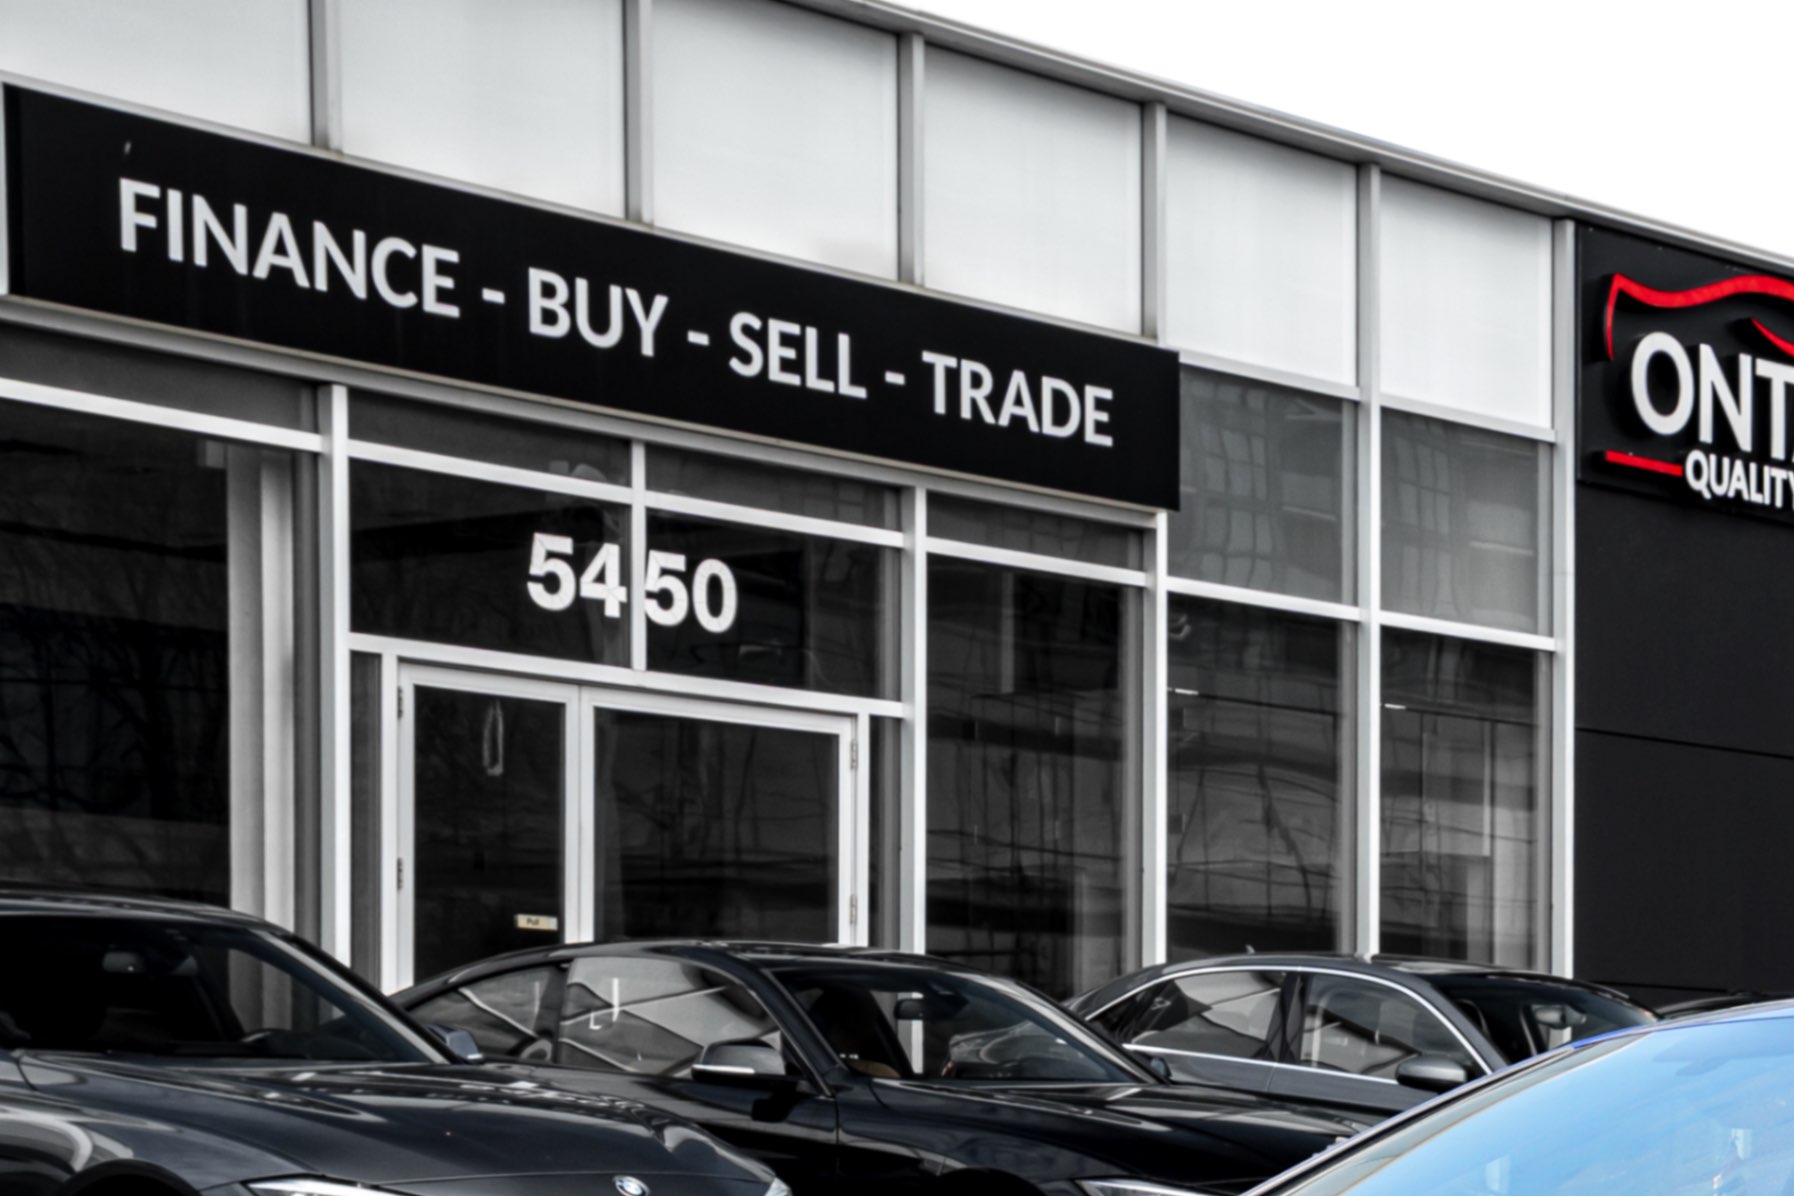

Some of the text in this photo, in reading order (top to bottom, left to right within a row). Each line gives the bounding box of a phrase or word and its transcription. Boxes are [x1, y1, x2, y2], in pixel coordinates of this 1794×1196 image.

[119, 178, 461, 318] FINANCE
[528, 267, 669, 357] BUY
[729, 312, 867, 399] SELL
[921, 350, 1113, 447] TRADE
[526, 532, 738, 634] 5450
